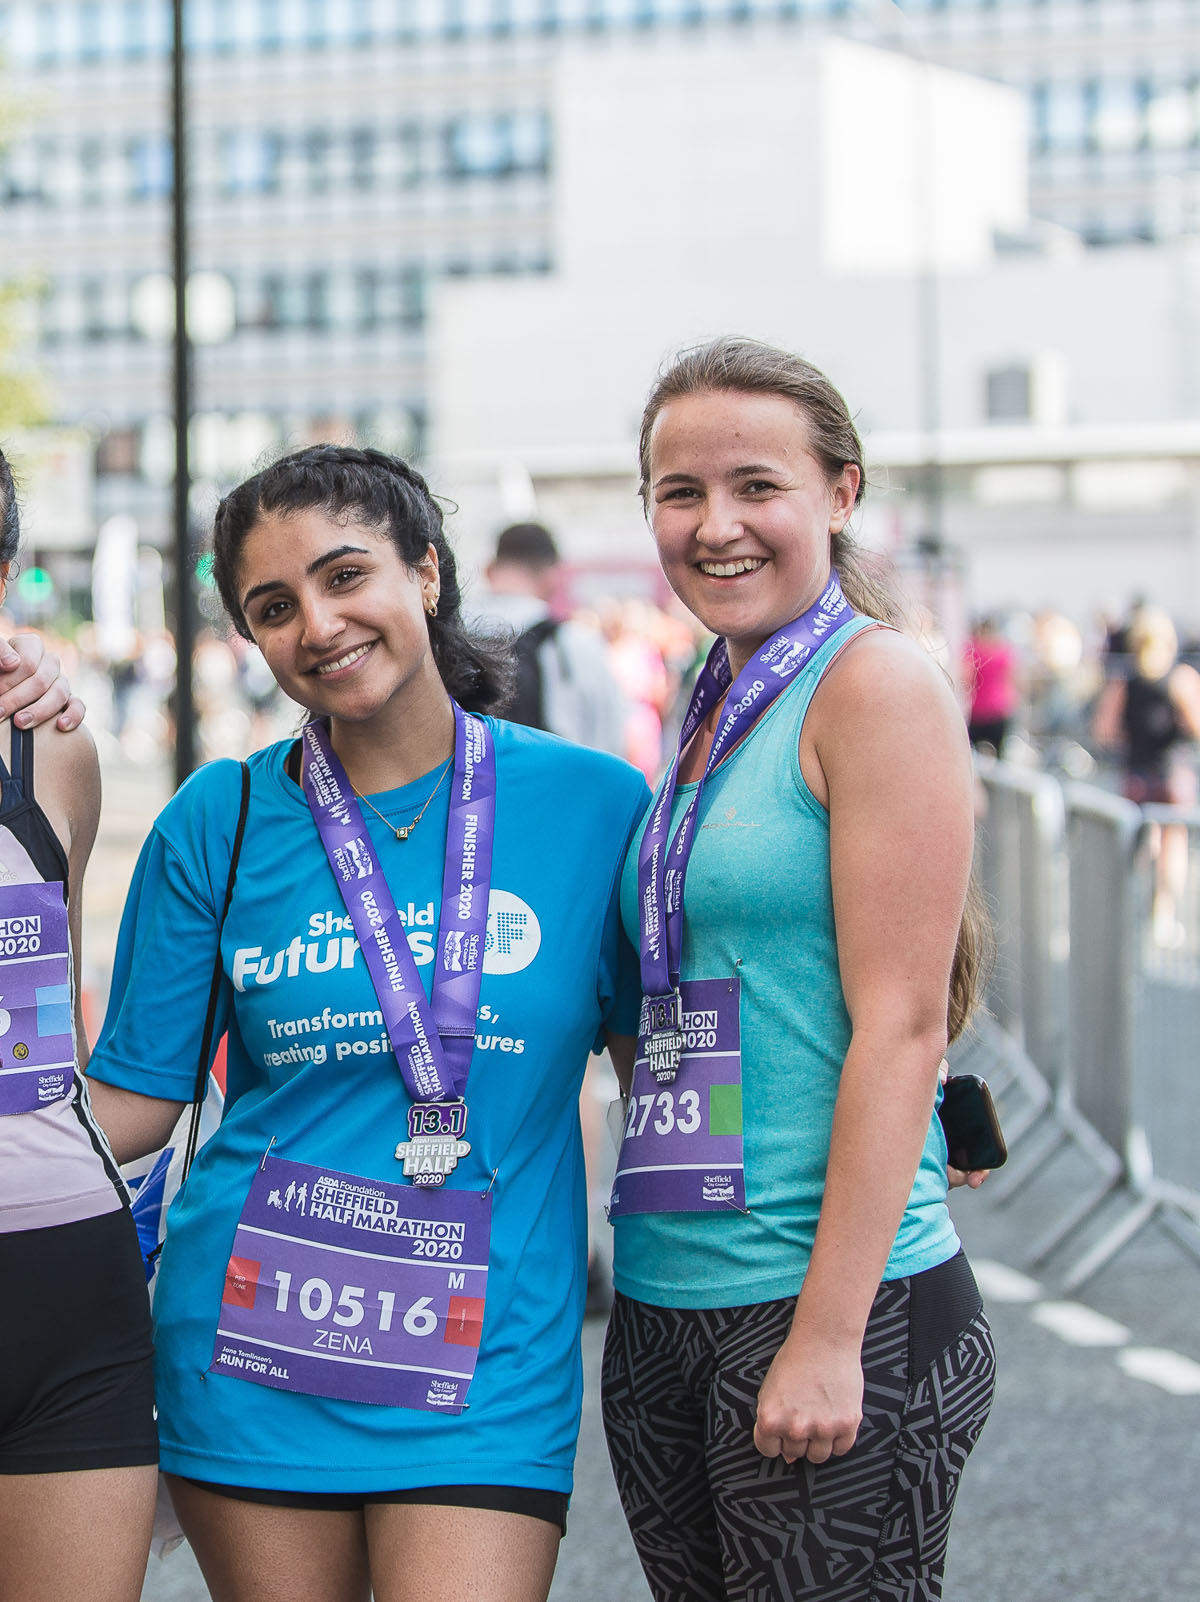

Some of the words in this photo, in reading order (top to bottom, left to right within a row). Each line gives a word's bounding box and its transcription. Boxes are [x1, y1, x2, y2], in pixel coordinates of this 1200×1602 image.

[759, 635, 790, 664] Sheffield
[706, 713, 738, 772] NISHER
[733, 680, 765, 714] 2020
[304, 726, 332, 778] MARATHON
[309, 761, 334, 806] SHEFFIELD
[461, 740, 474, 801] MARATHON
[326, 778, 343, 801] HALF
[461, 814, 478, 881] FINISHER
[333, 848, 353, 882] Sheffield
[651, 843, 660, 904] MARATHON
[360, 890, 383, 927] 2020
[458, 883, 474, 920] 2020
[645, 885, 654, 935] SHEFFIELD
[308, 902, 434, 937] Sheeld
[232, 931, 435, 993] Futurs
[374, 926, 406, 993] FINISHER
[467, 934, 479, 971] Sheffield
[267, 1007, 383, 1039] Transform
[651, 1001, 676, 1030] 13.1
[407, 1001, 434, 1064] MARATHON
[644, 1036, 682, 1055] SHEFFIELD
[410, 1045, 433, 1095] SHEFFIELD
[650, 1051, 677, 1072] HALF
[656, 1070, 671, 1082] 2020
[38, 1074, 64, 1085] Sheffield
[428, 1066, 442, 1092] HALF
[413, 1108, 462, 1134] 13.1
[397, 1143, 468, 1157] SHEFFIELD
[405, 1156, 455, 1173] HALF
[317, 1175, 339, 1189] ASDA
[339, 1181, 386, 1198] Foundation
[415, 1174, 442, 1184] 2020
[703, 1175, 731, 1183] Sheffield
[313, 1186, 396, 1215] SHEFFIELD
[309, 1202, 354, 1225] HALF
[355, 1212, 463, 1240] MARATHON
[411, 1239, 463, 1260] 2020
[232, 1282, 247, 1290] ZONE
[234, 1274, 246, 1282] RED
[448, 1272, 466, 1290] M
[274, 1270, 438, 1337] 10516
[222, 1346, 237, 1355] Jane
[238, 1350, 273, 1364] Tomlinson's
[312, 1328, 374, 1356] ZENA
[220, 1353, 244, 1369] RUN
[245, 1360, 267, 1374] FOR
[268, 1366, 290, 1380] ALL
[430, 1379, 459, 1391] Sheffield
